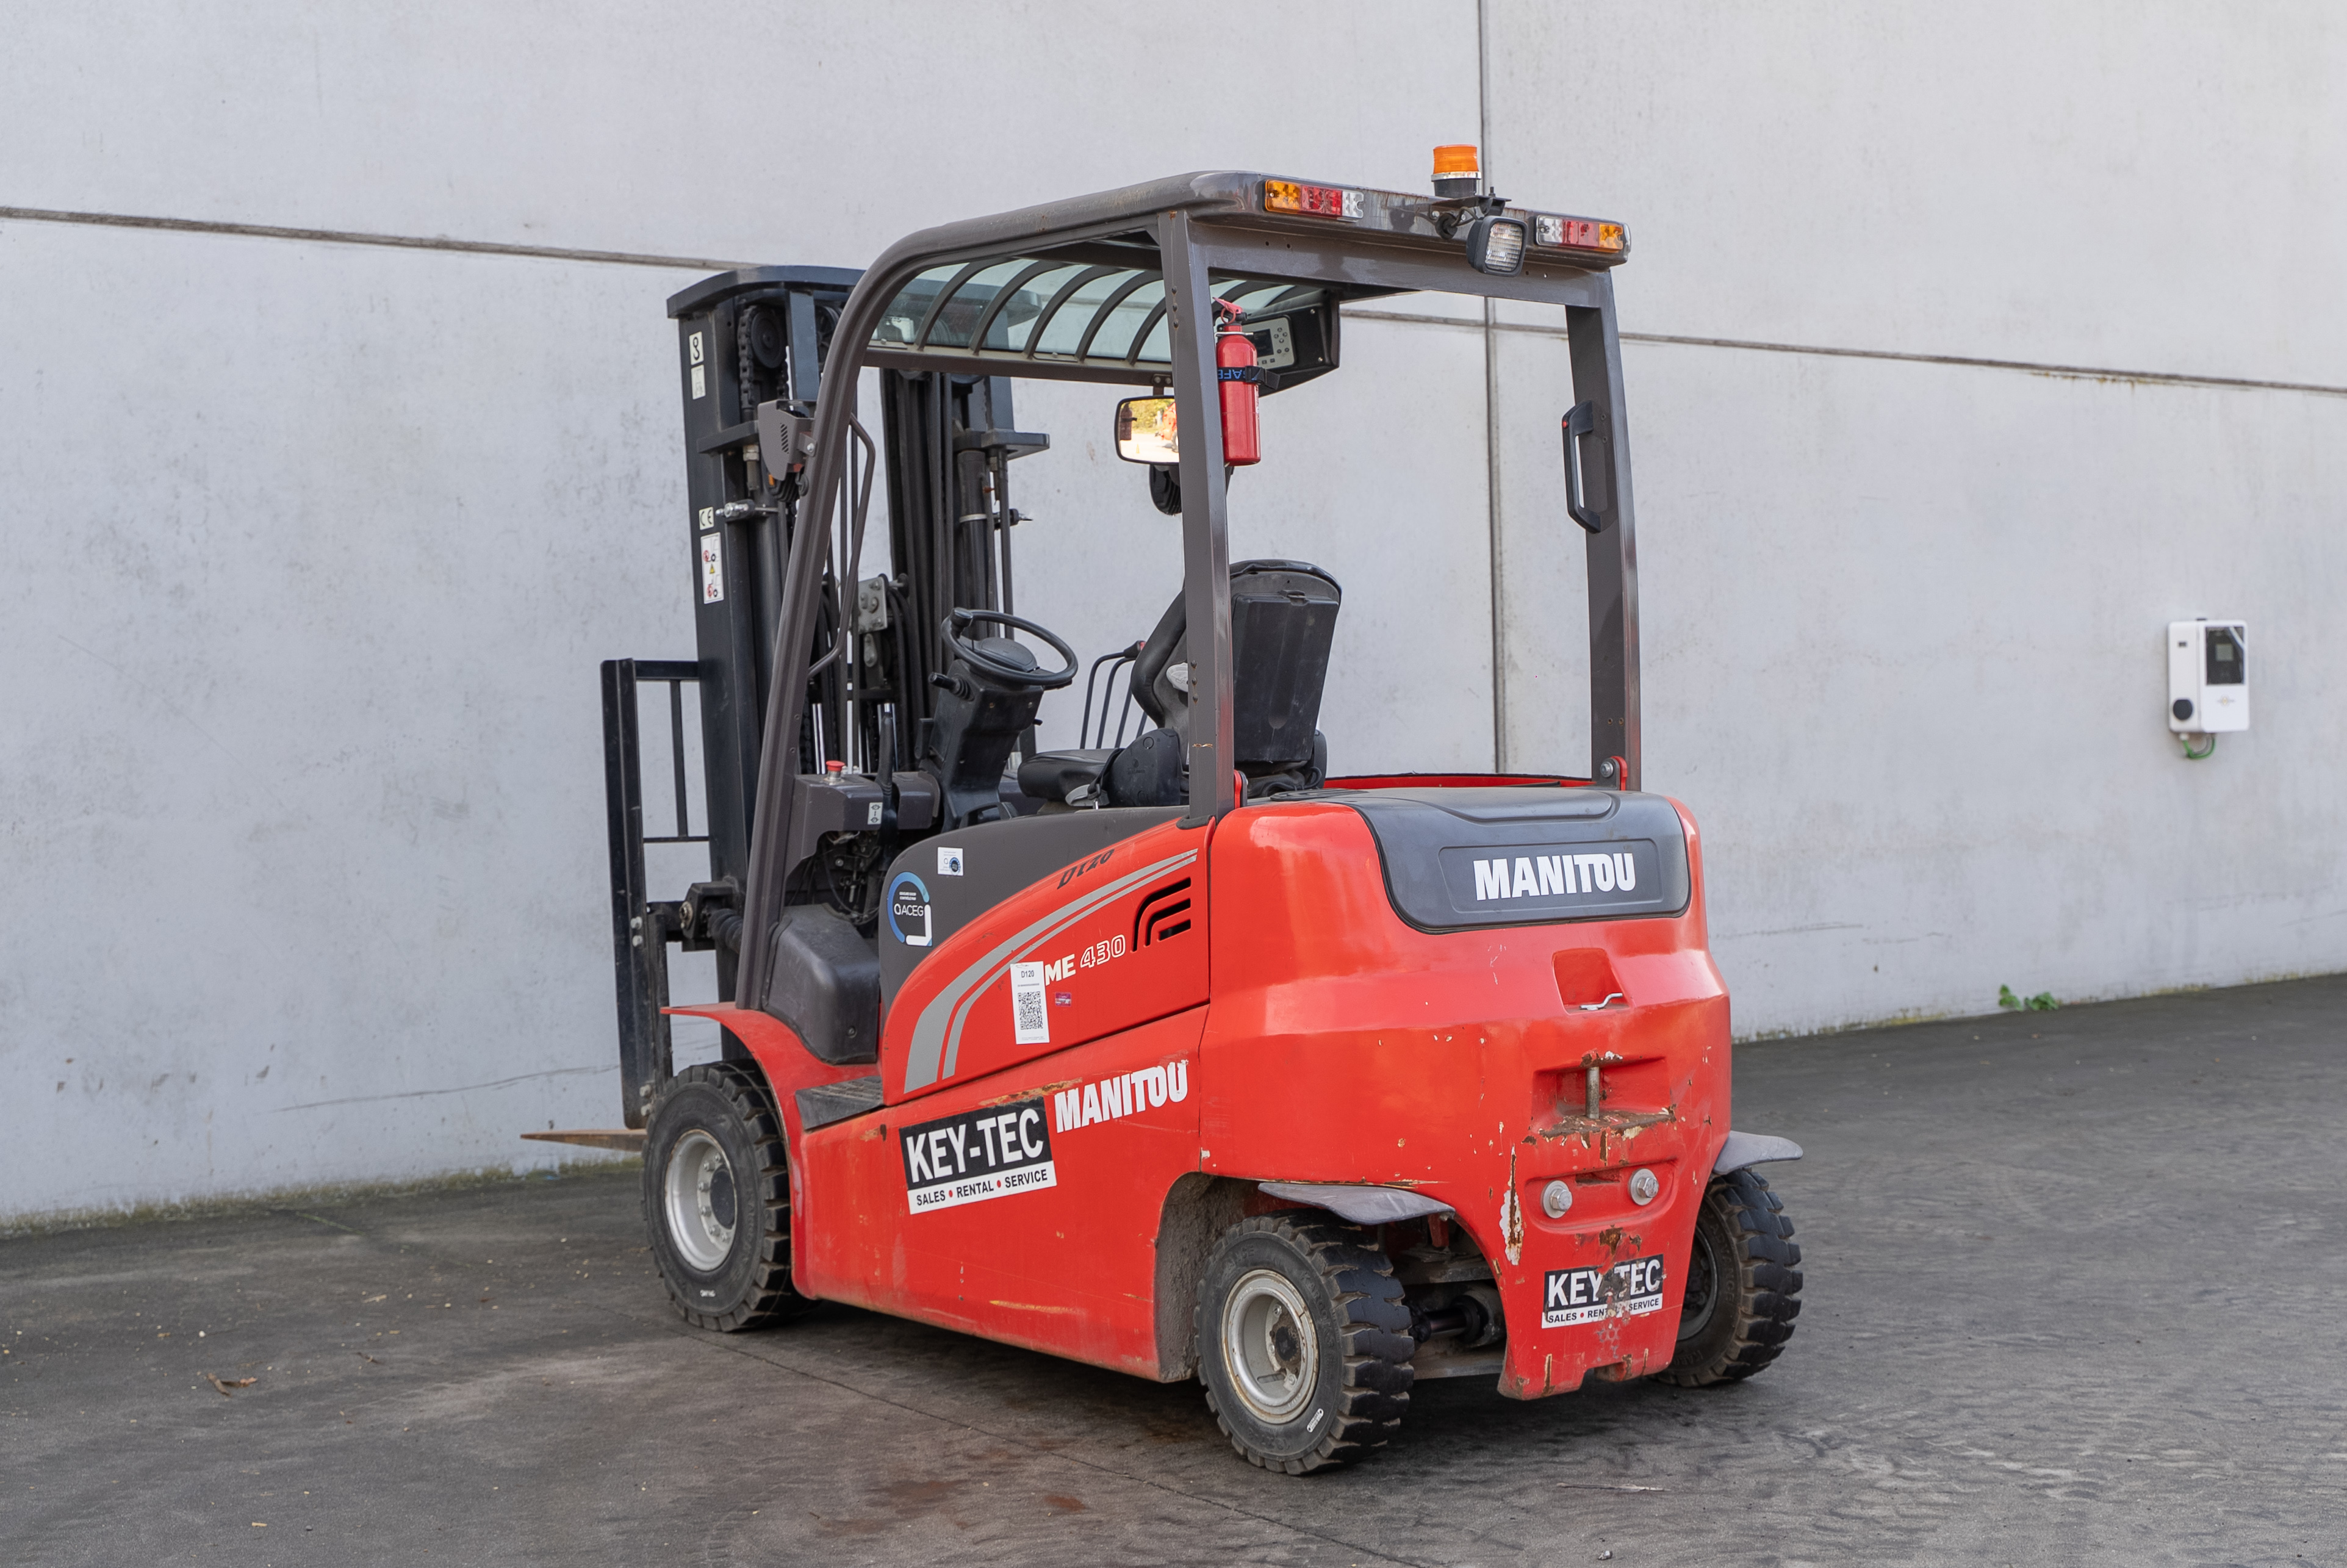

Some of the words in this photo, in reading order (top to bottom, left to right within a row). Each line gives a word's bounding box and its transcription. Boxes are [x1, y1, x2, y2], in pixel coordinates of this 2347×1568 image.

[1473, 853, 1636, 901] MANITOU
[1021, 969, 1035, 978] D120
[1044, 954, 1076, 987] ME
[1079, 934, 1126, 969] 430
[1054, 1059, 1189, 1134] MANITOU
[906, 1108, 1044, 1183] KEY-TEC
[916, 1190, 946, 1206] SALES
[956, 1181, 994, 1198] RENTAL
[1005, 1169, 1048, 1189] SERVICE
[1548, 1312, 1577, 1323] SALES
[1628, 1298, 1659, 1311] SERVICE
